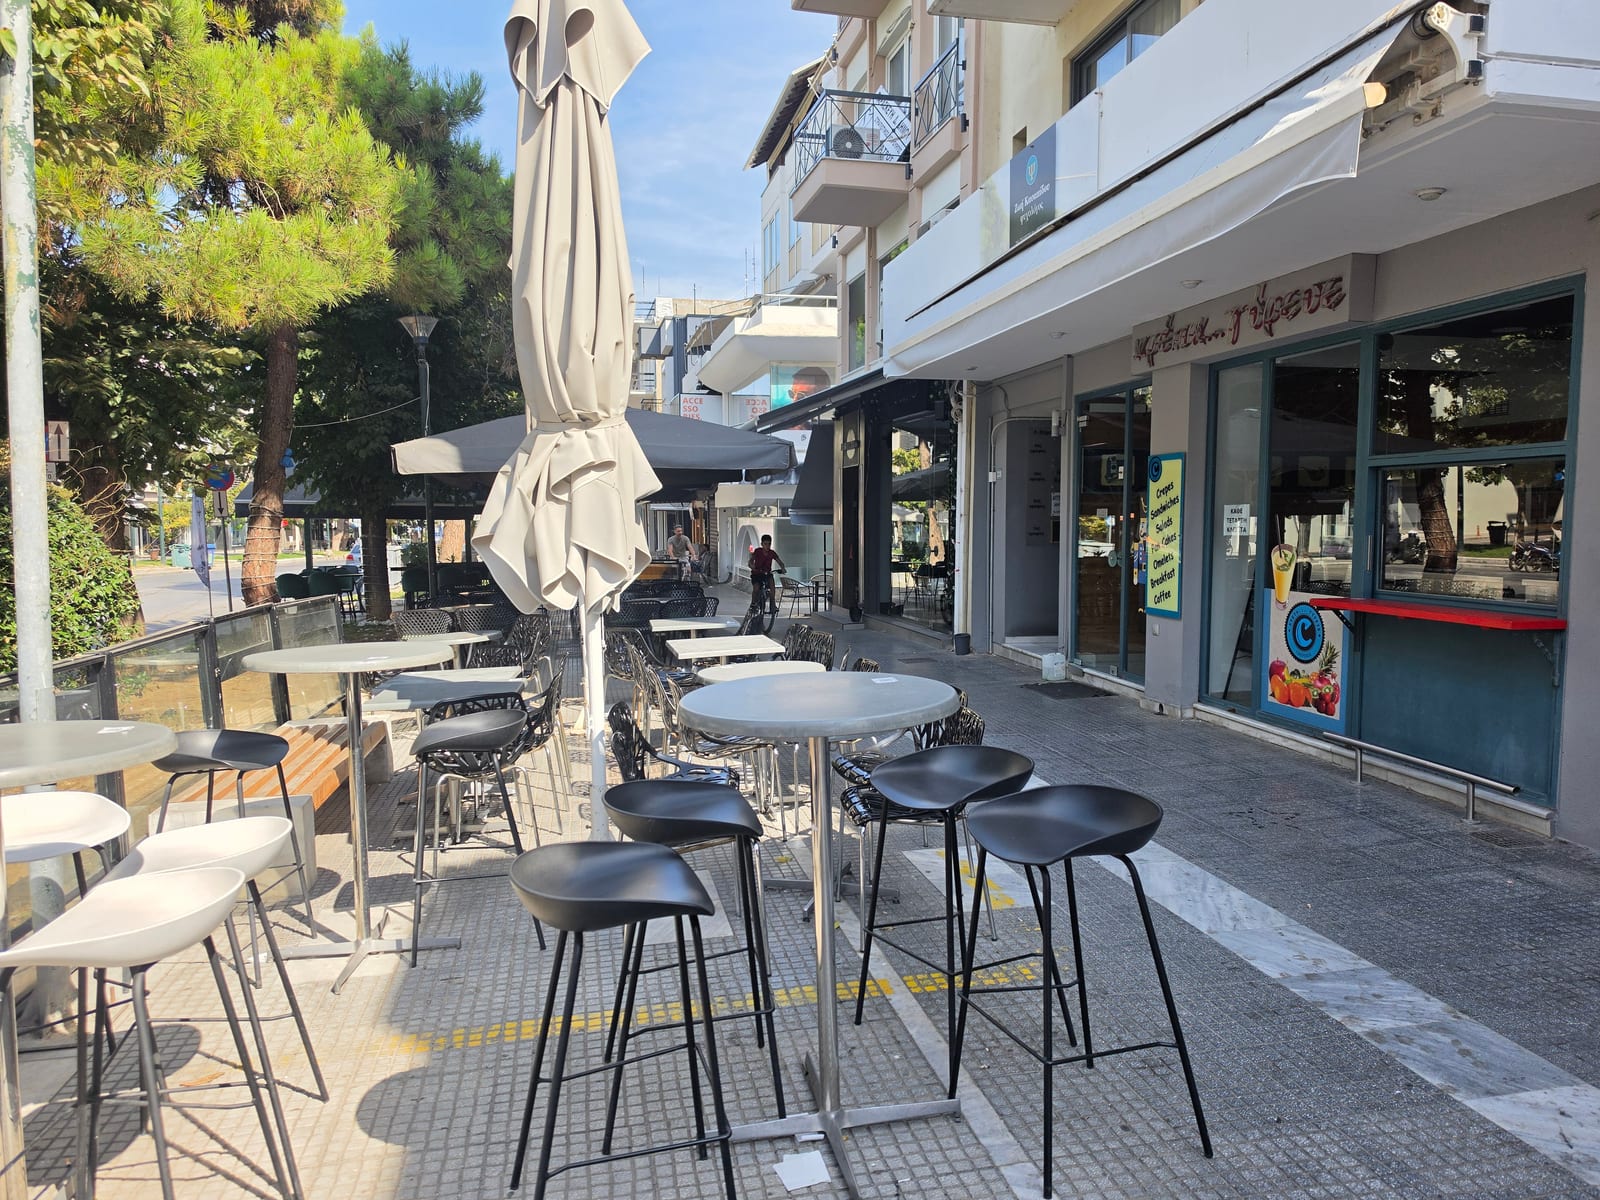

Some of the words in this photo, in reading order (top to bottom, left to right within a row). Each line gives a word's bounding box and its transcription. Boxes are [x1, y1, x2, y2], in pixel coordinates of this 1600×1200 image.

[1156, 482, 1174, 499] Crepes
[1151, 496, 1179, 520] Sandwiches
[1156, 516, 1173, 534] Salads
[1153, 553, 1174, 570] Omelets
[1150, 568, 1175, 589] Breakfast
[1154, 590, 1171, 605] Coffee
